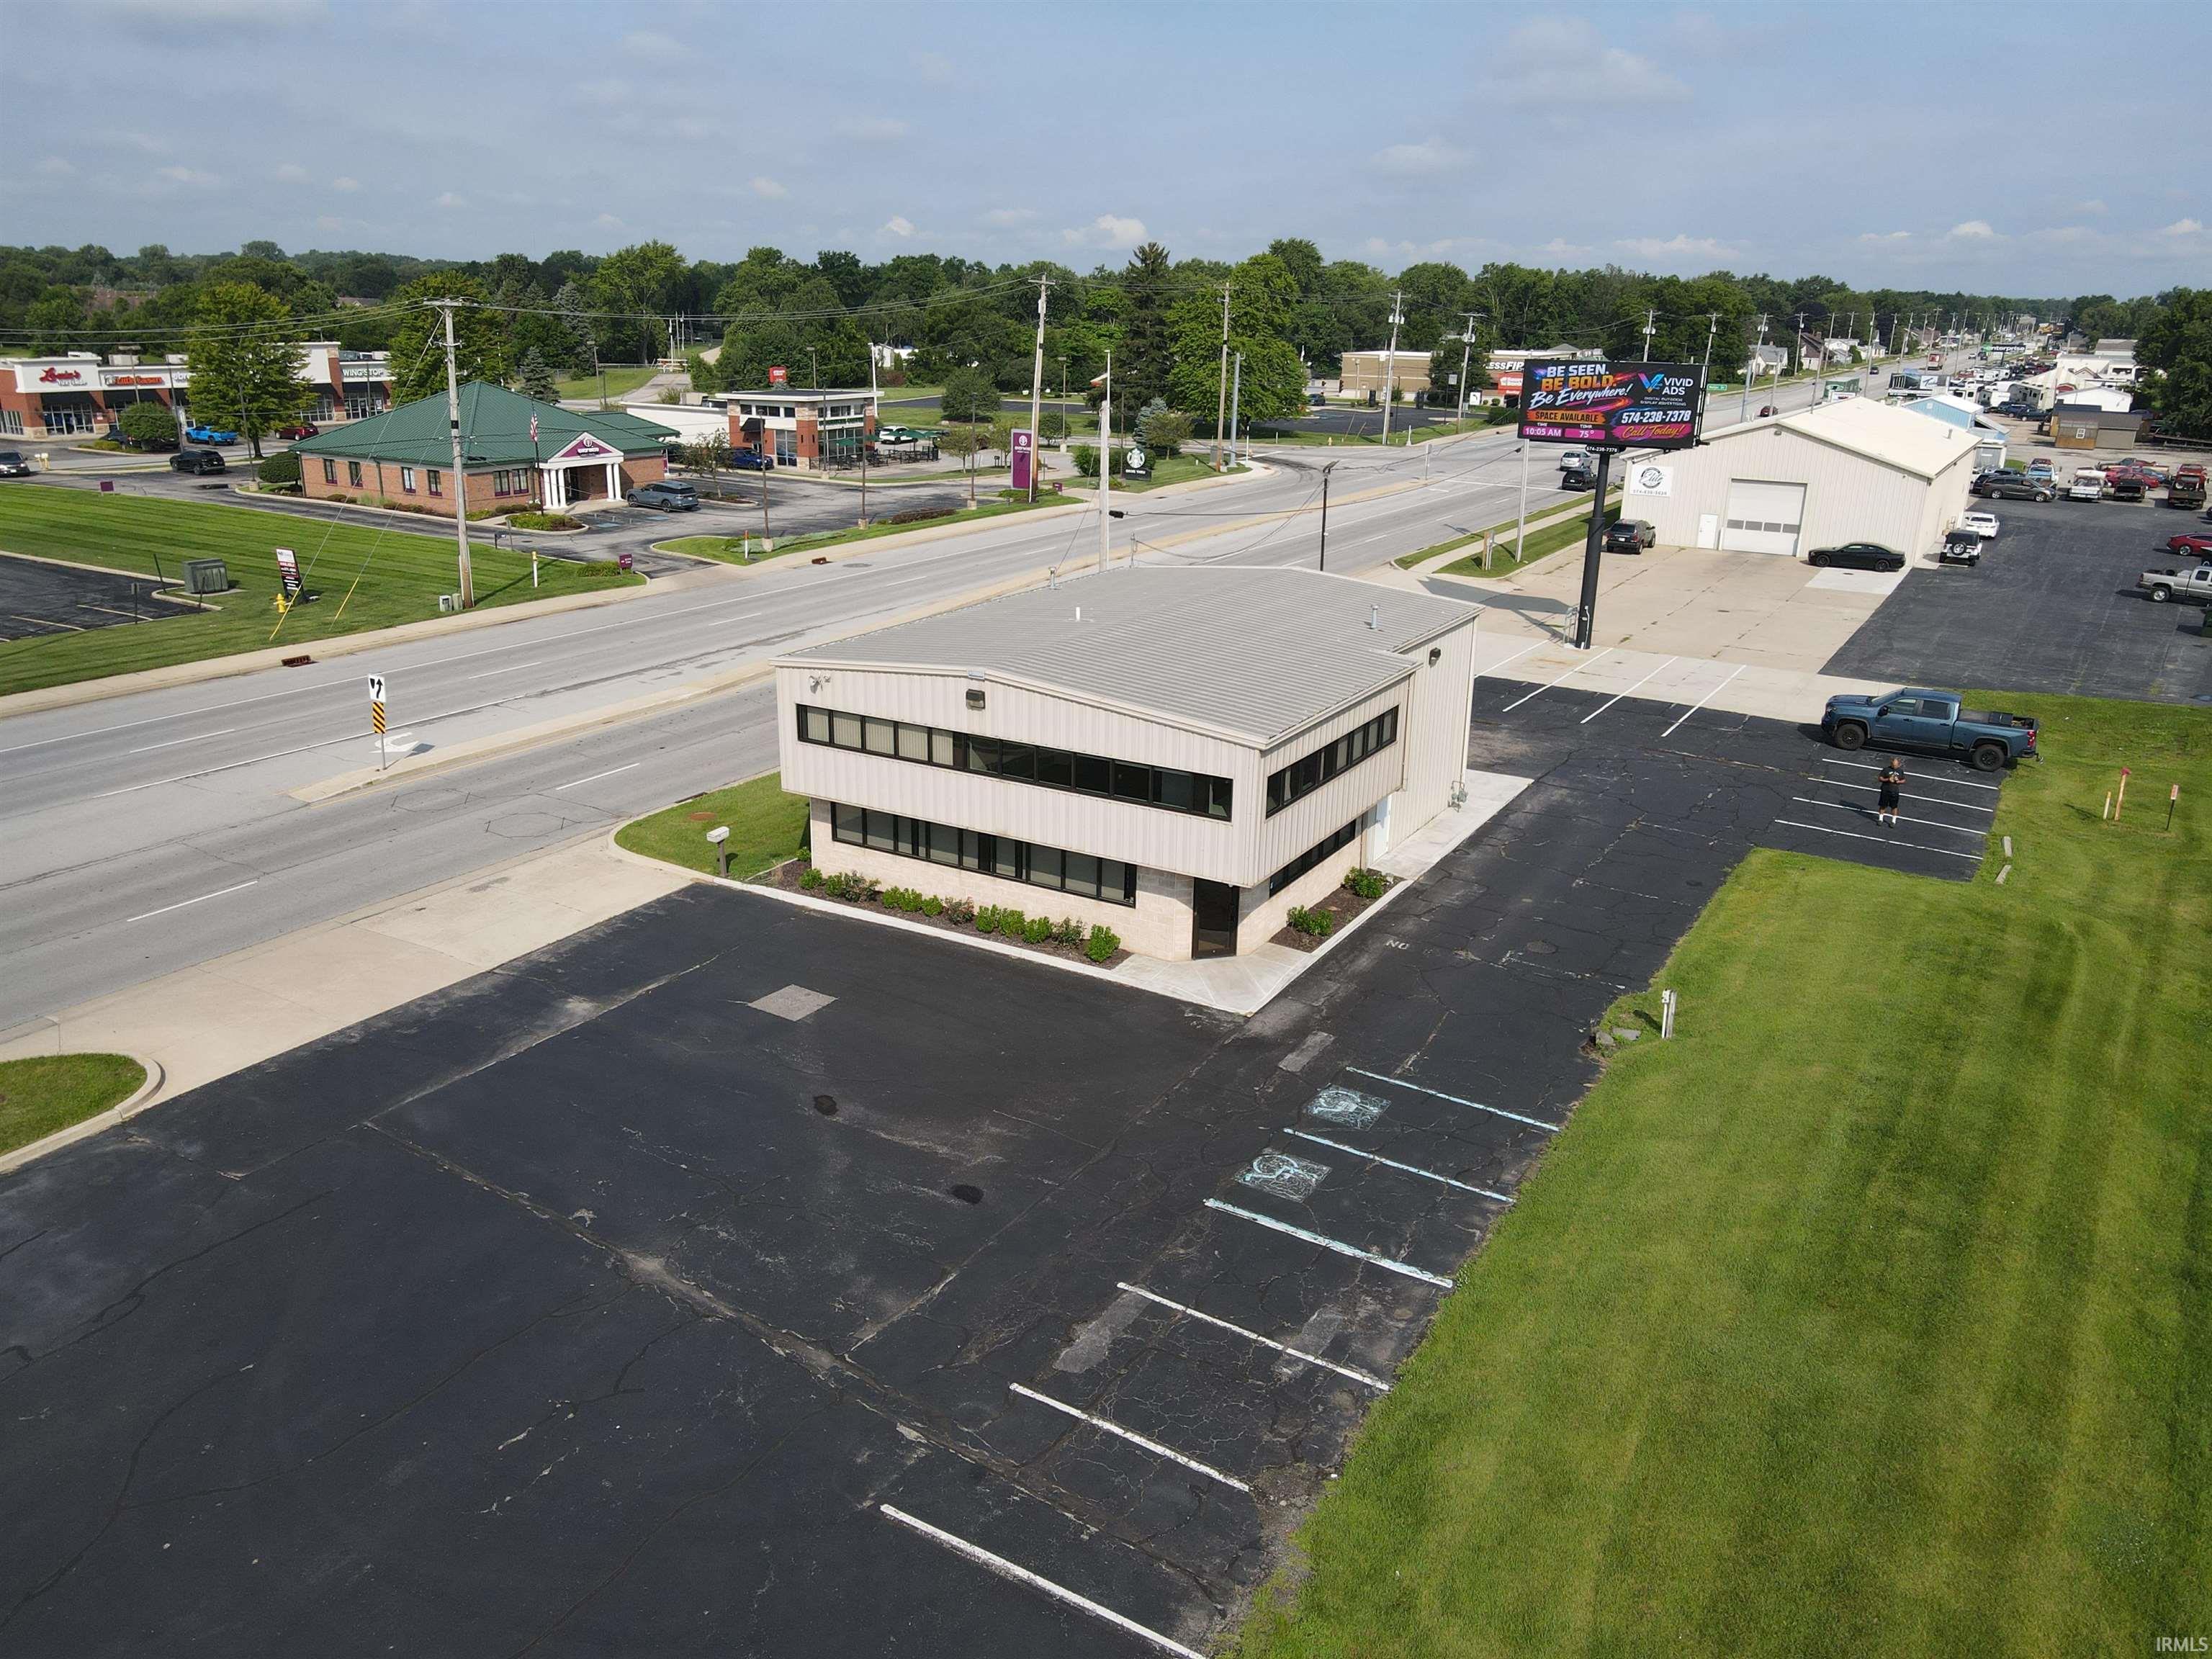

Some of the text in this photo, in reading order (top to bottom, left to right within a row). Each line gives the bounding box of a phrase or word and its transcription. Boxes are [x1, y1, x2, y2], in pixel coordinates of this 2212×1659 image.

[1547, 364, 1609, 377] BE SEEN.
[1542, 375, 1617, 392] BE BOLD.
[1664, 377, 1694, 387] VIVID
[1529, 383, 1633, 410] Be Everywhere!
[1662, 387, 1686, 395] ADS
[1535, 411, 1599, 423] SPACE AVAILABLE
[1621, 410, 1692, 423] 574-238-7378
[1622, 424, 1685, 439] Call Today!
